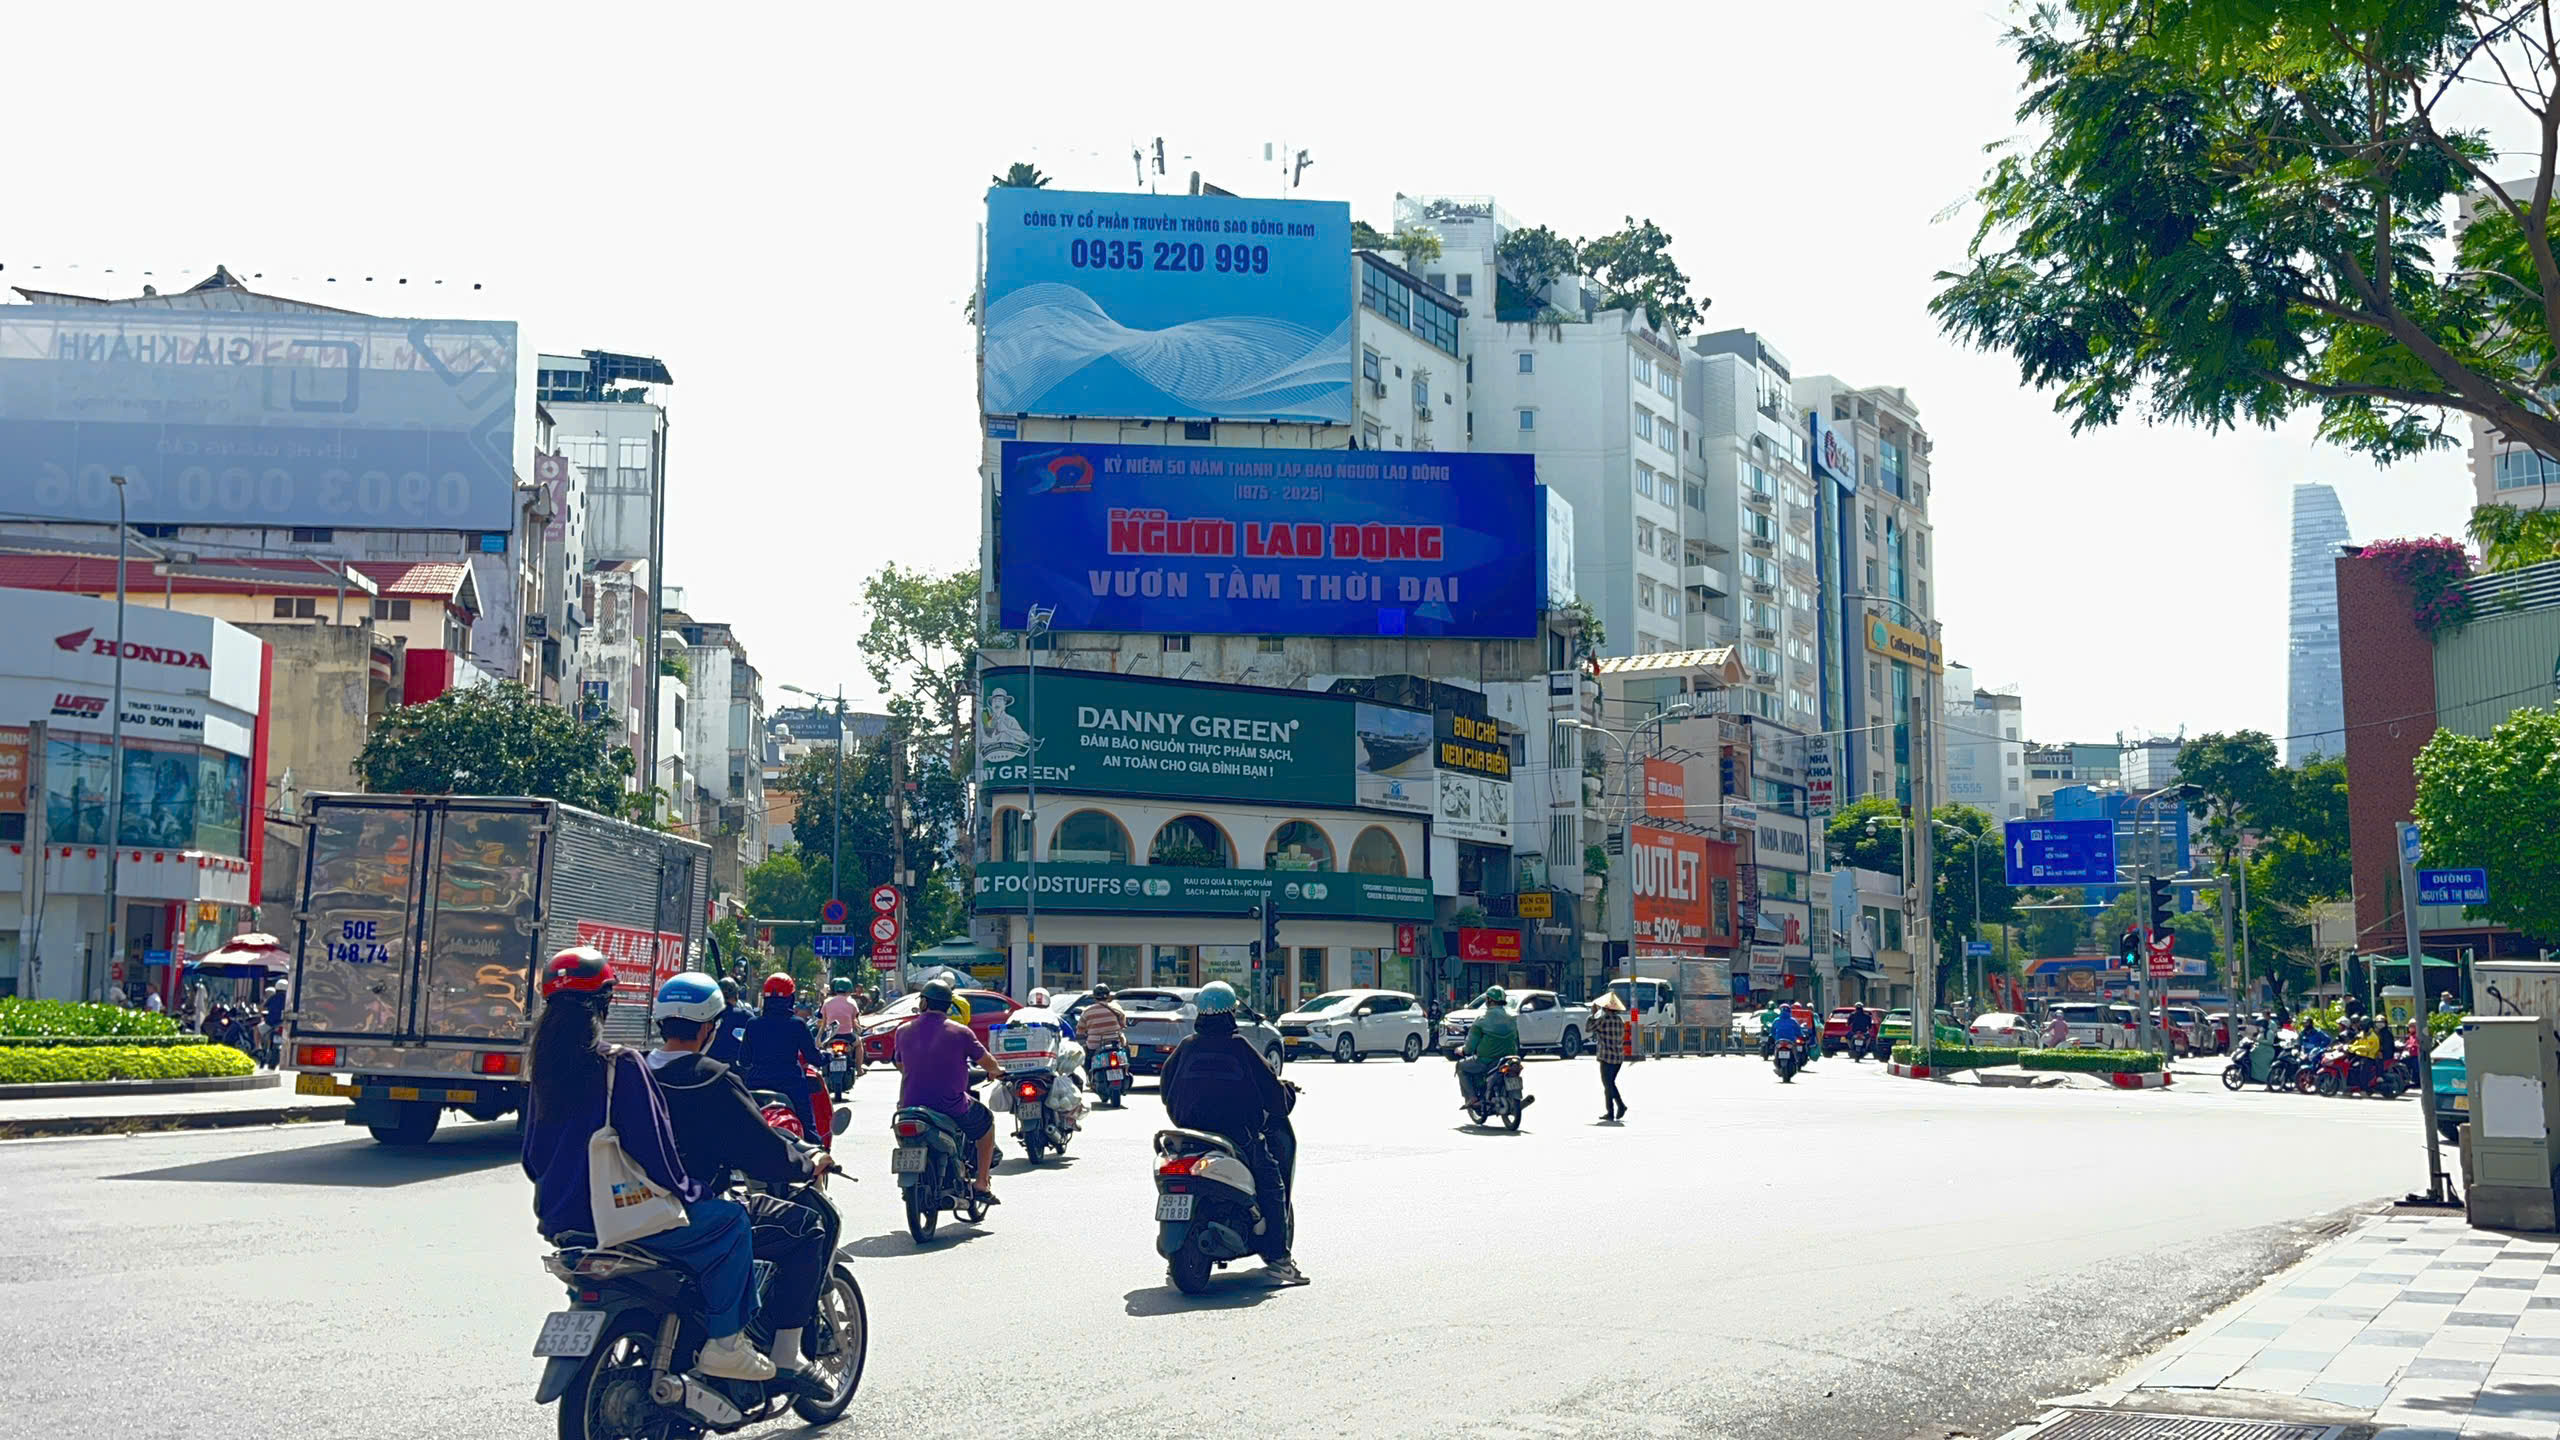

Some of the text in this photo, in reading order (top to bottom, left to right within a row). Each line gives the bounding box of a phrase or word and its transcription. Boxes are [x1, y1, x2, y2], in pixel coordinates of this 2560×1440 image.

[1024, 209, 1315, 237] CÔNG TY CỔ PHẦN TRUYỀN THÔNG SAO ĐÔNG NAM
[1071, 238, 1269, 274] 0935 220 999
[1168, 460, 1185, 475] 50
[1383, 465, 1407, 480] LAO
[1109, 518, 1443, 562] NGƯỜI LAO ĐỘNG
[1089, 565, 1459, 607] VƯƠN TẦM THỜI ĐẠI
[93, 637, 211, 670] HONDA
[150, 716, 173, 728] SƠN
[1077, 706, 1185, 735] DANNY
[1453, 714, 1475, 739] BÚN
[1080, 733, 1293, 763] ĐẢM BẢO NGUỒN THỰC PHẨM SẠCH,
[1442, 743, 1463, 766] NEM
[1465, 748, 1484, 769] CUA
[1809, 755, 1828, 764] NHA
[2039, 754, 2071, 764] HOTEL
[1103, 755, 1121, 767] AN
[1124, 755, 1157, 771] TOÀN
[1159, 759, 1186, 772] CHO
[1189, 761, 1210, 774] GIA
[1212, 761, 1240, 776] ĐÌNH
[1243, 765, 1267, 780] BẠN
[1807, 767, 1832, 777] KHOA
[1808, 779, 1832, 791] TÂM
[2149, 801, 2178, 810] SORTS
[1760, 826, 1805, 856] NHA KHOA
[1184, 878, 1199, 886] RAU
[1632, 842, 1699, 901] OUTLET
[2432, 873, 2472, 884] ĐƯỜNG
[994, 876, 1121, 895] FOODSTUFFS
[343, 920, 377, 940] 50E
[1634, 920, 1642, 935] EAL
[1655, 917, 1681, 944] 50%
[327, 943, 389, 964] 148.74
[551, 1315, 596, 1332] 59-N2
